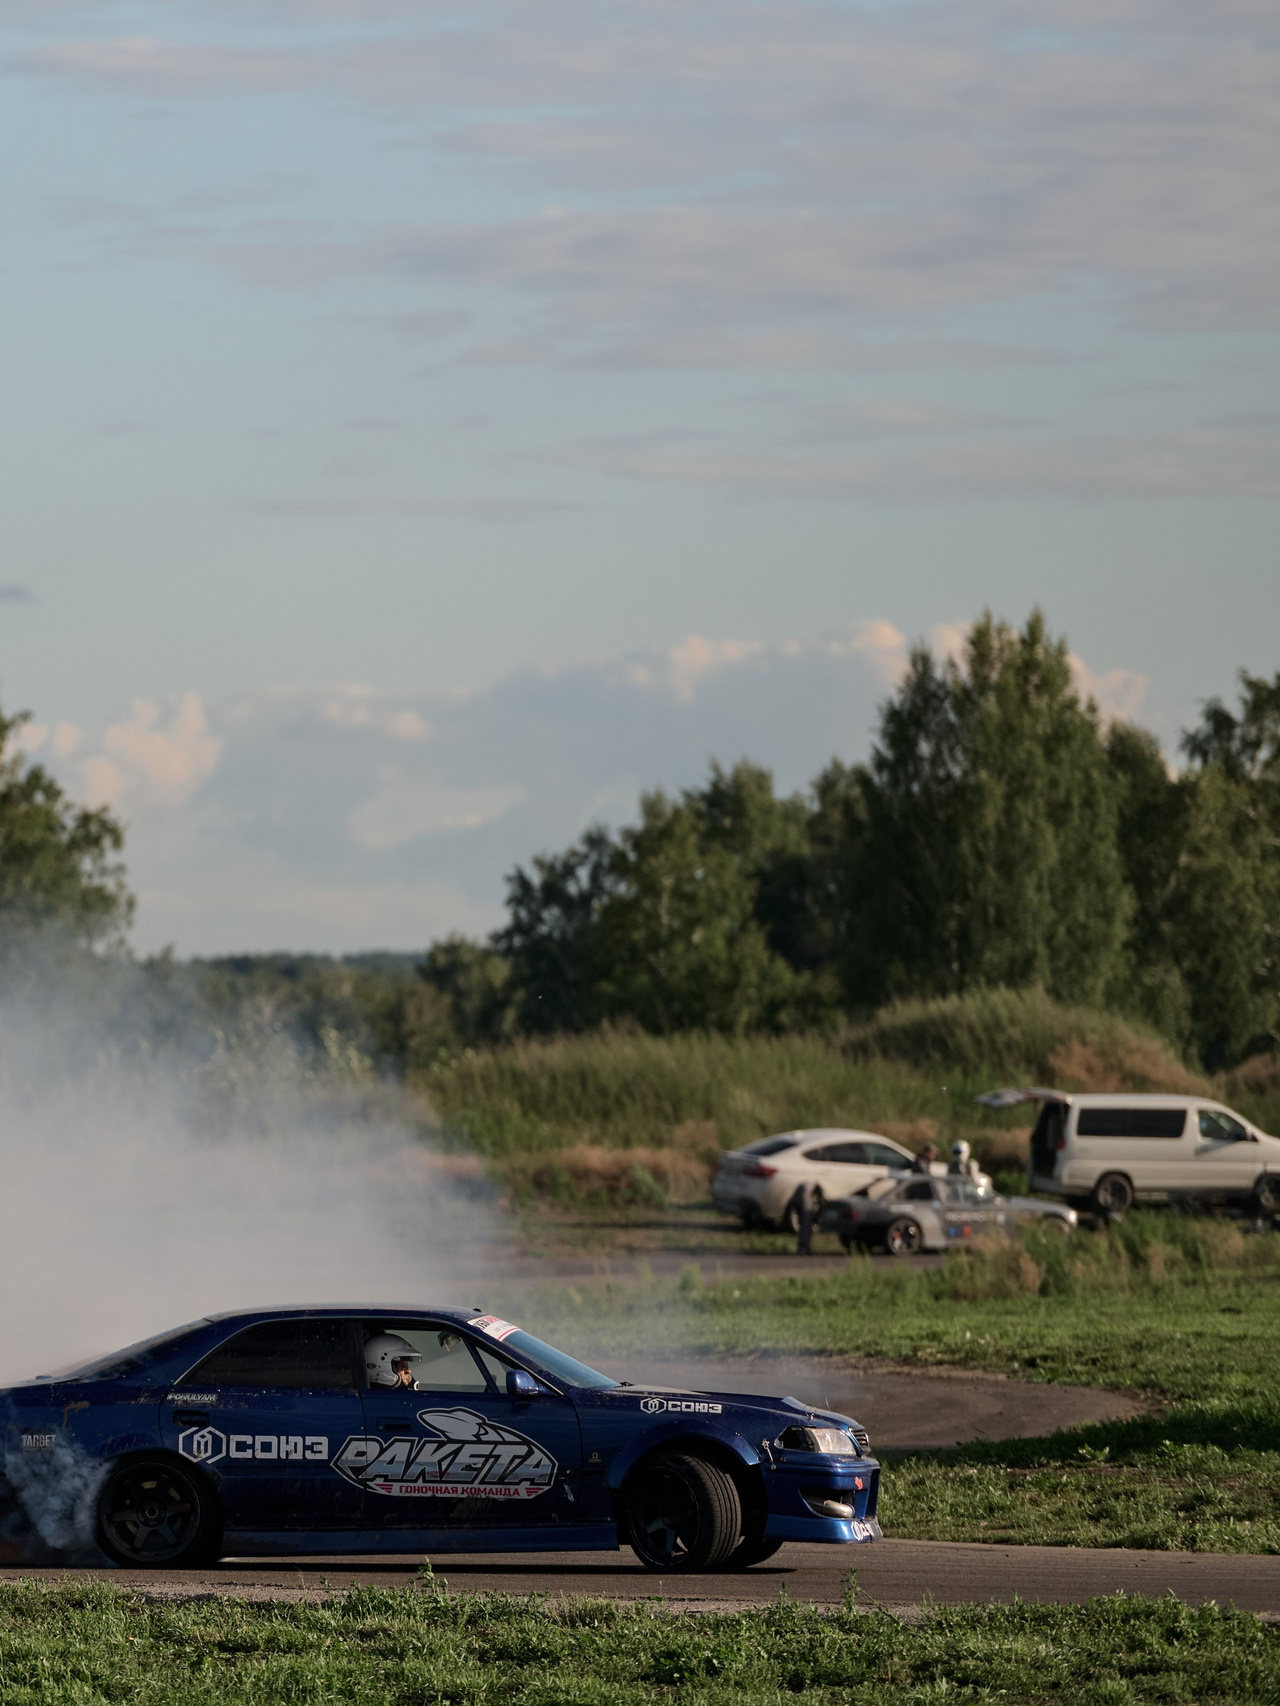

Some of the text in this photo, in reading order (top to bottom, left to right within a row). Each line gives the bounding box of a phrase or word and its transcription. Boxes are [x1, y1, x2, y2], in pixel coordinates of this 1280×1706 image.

[668, 1401, 722, 1414] СОЮЗ
[21, 1434, 57, 1447] TARGET
[229, 1434, 329, 1460] СОЮЗ
[335, 1438, 554, 1484] РАКЕТА
[399, 1484, 520, 1497] ГОНОЧНАЯ КОМАНДА
